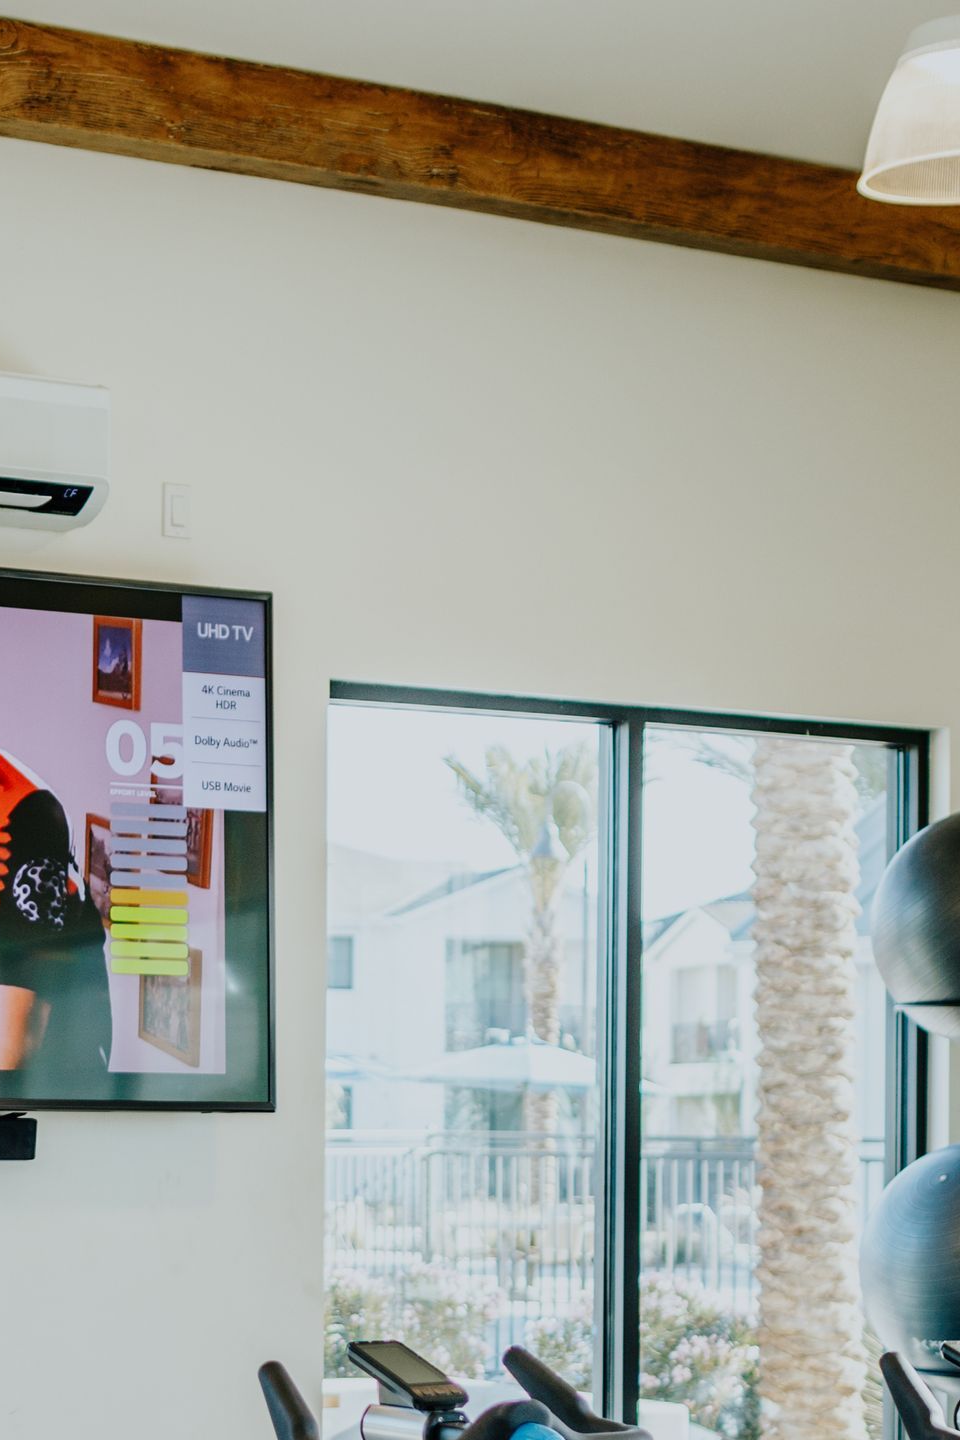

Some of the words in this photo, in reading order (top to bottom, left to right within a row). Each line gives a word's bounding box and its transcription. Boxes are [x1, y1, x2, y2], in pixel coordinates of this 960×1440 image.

[197, 621, 230, 639] UHD
[232, 625, 254, 642] TV
[201, 684, 214, 696] 4K
[216, 685, 251, 698] Cinema
[215, 699, 237, 711] HDR
[105, 719, 184, 779] 05
[194, 735, 221, 749] Dolby
[201, 780, 222, 791] USB
[223, 781, 252, 793] Movie
